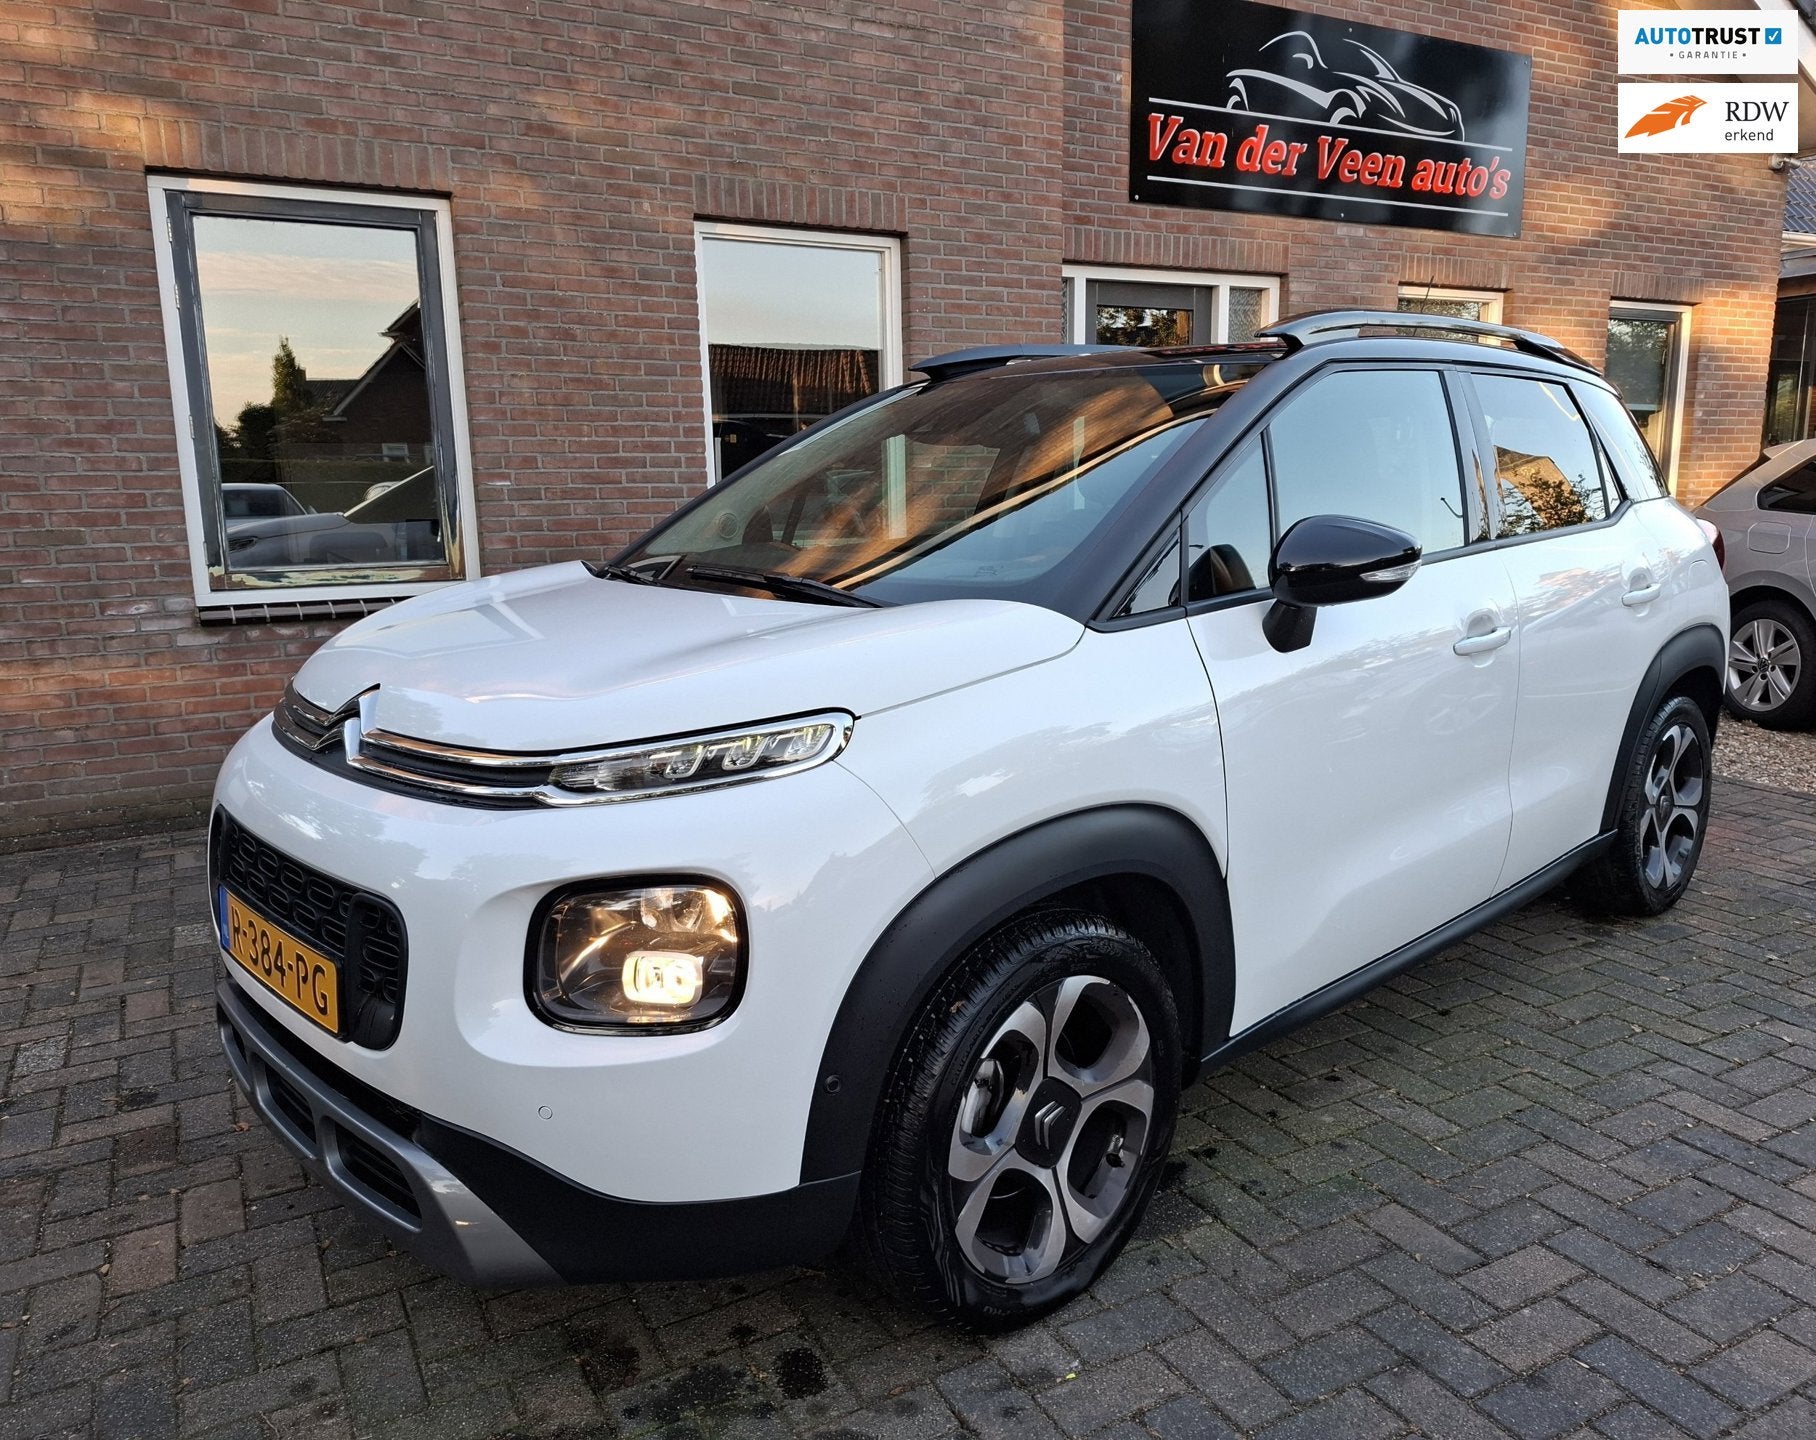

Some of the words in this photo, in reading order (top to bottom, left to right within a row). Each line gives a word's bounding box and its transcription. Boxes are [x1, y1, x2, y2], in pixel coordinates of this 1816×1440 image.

[1148, 113, 1227, 169] Van
[1236, 124, 1308, 176] der
[1316, 135, 1407, 189] Veen
[1411, 156, 1512, 200] auto's
[231, 903, 329, 1017] R-384-PG
